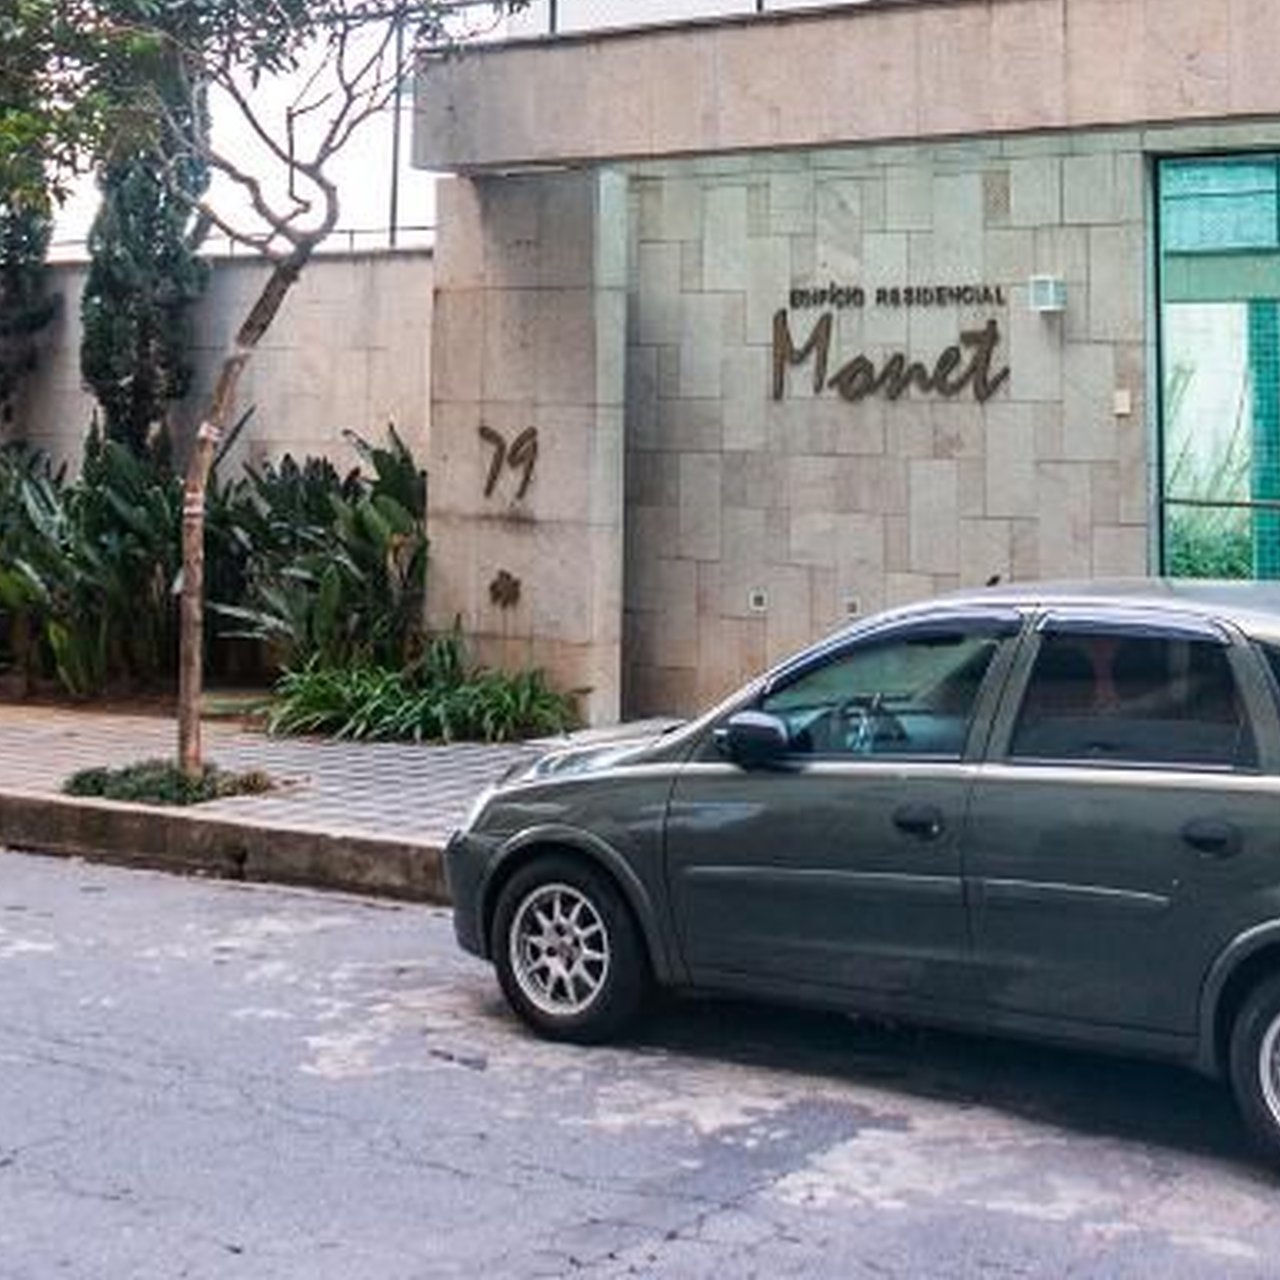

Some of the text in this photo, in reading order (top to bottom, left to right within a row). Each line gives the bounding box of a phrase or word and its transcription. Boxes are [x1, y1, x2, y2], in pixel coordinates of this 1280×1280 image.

[875, 285, 1006, 307] RESIDENCIAL
[773, 309, 1010, 403] Monet
[478, 425, 539, 500] 79
